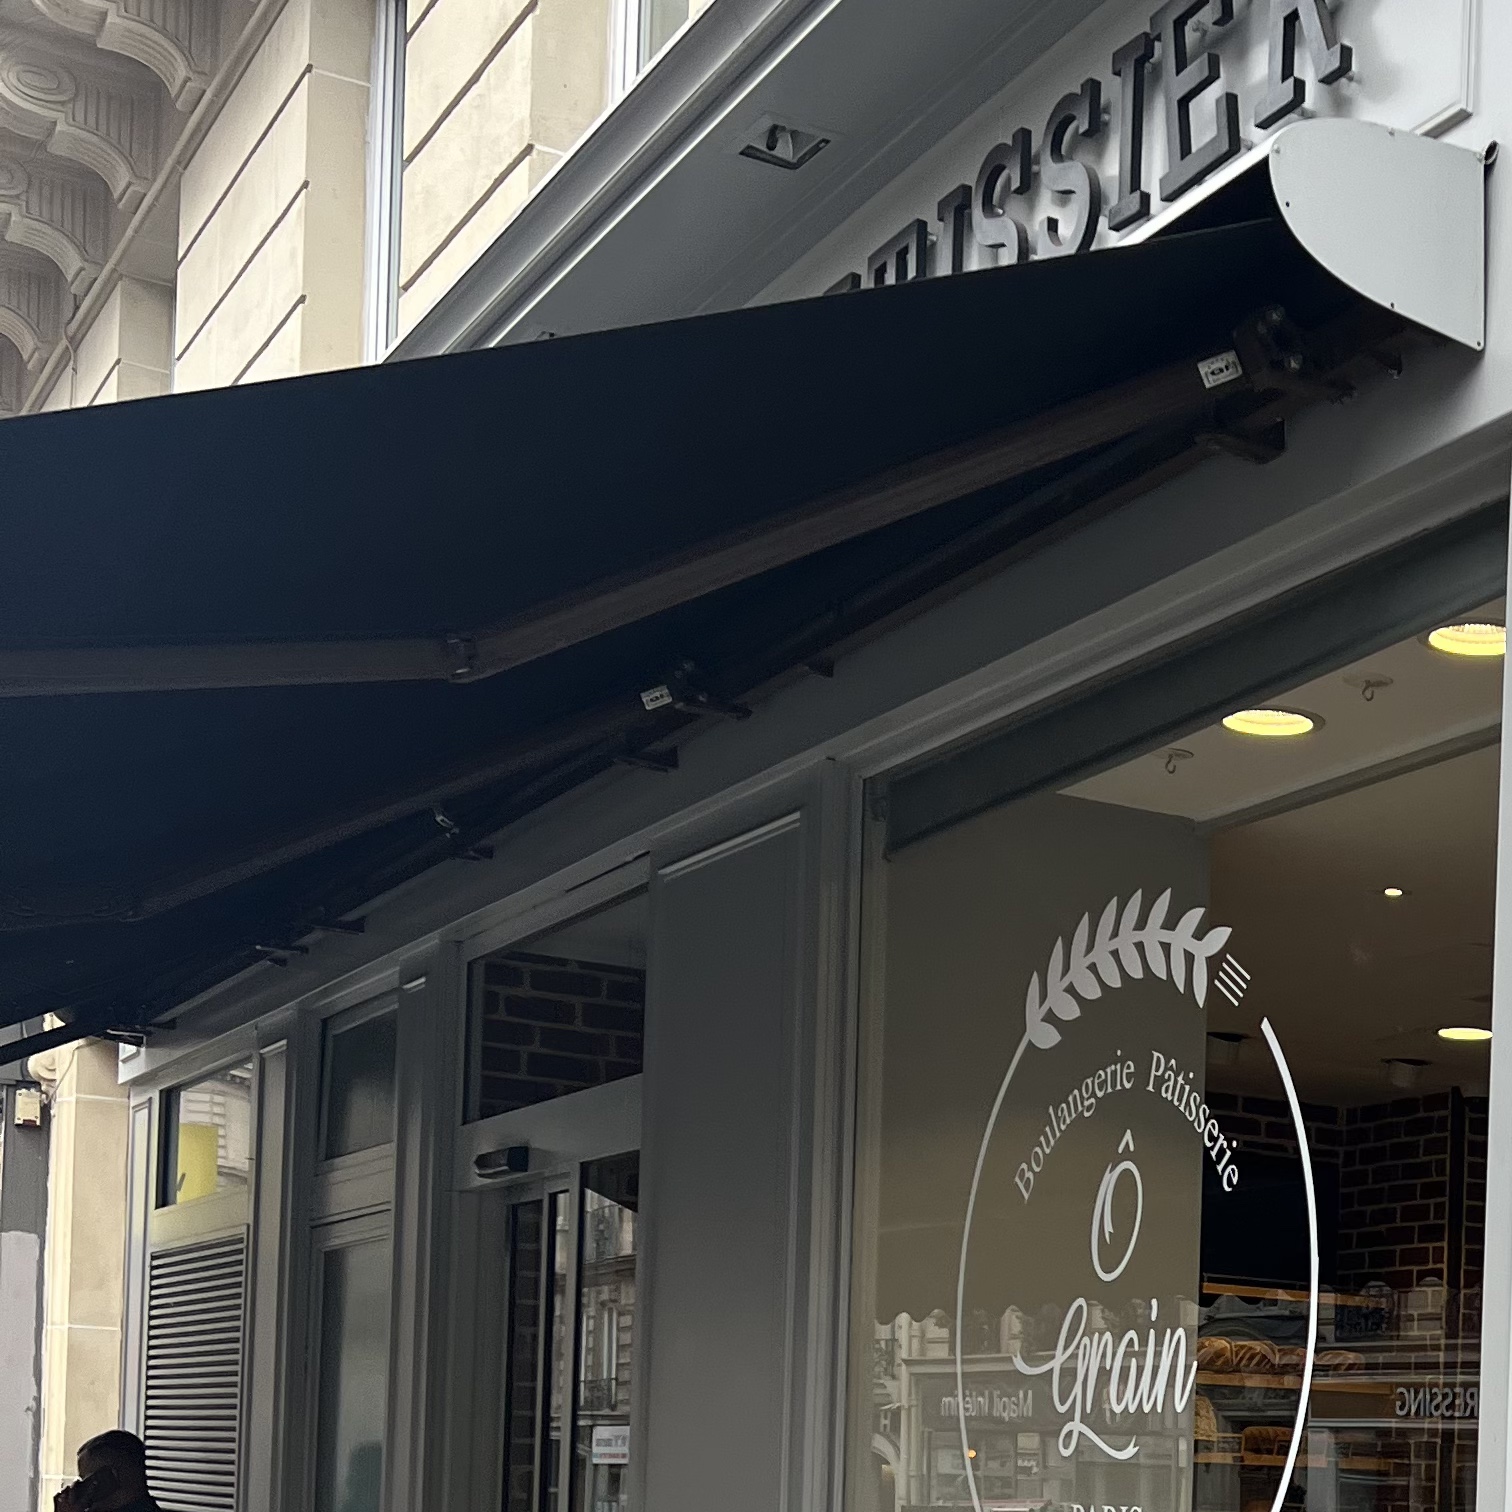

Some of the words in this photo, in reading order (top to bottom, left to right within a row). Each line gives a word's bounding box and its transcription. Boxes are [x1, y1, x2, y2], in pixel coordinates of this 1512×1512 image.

[1014, 1049, 1136, 1204] Boulangerie
[1145, 1050, 1239, 1192] Pâtisserie
[1012, 1297, 1198, 1459] Grain
